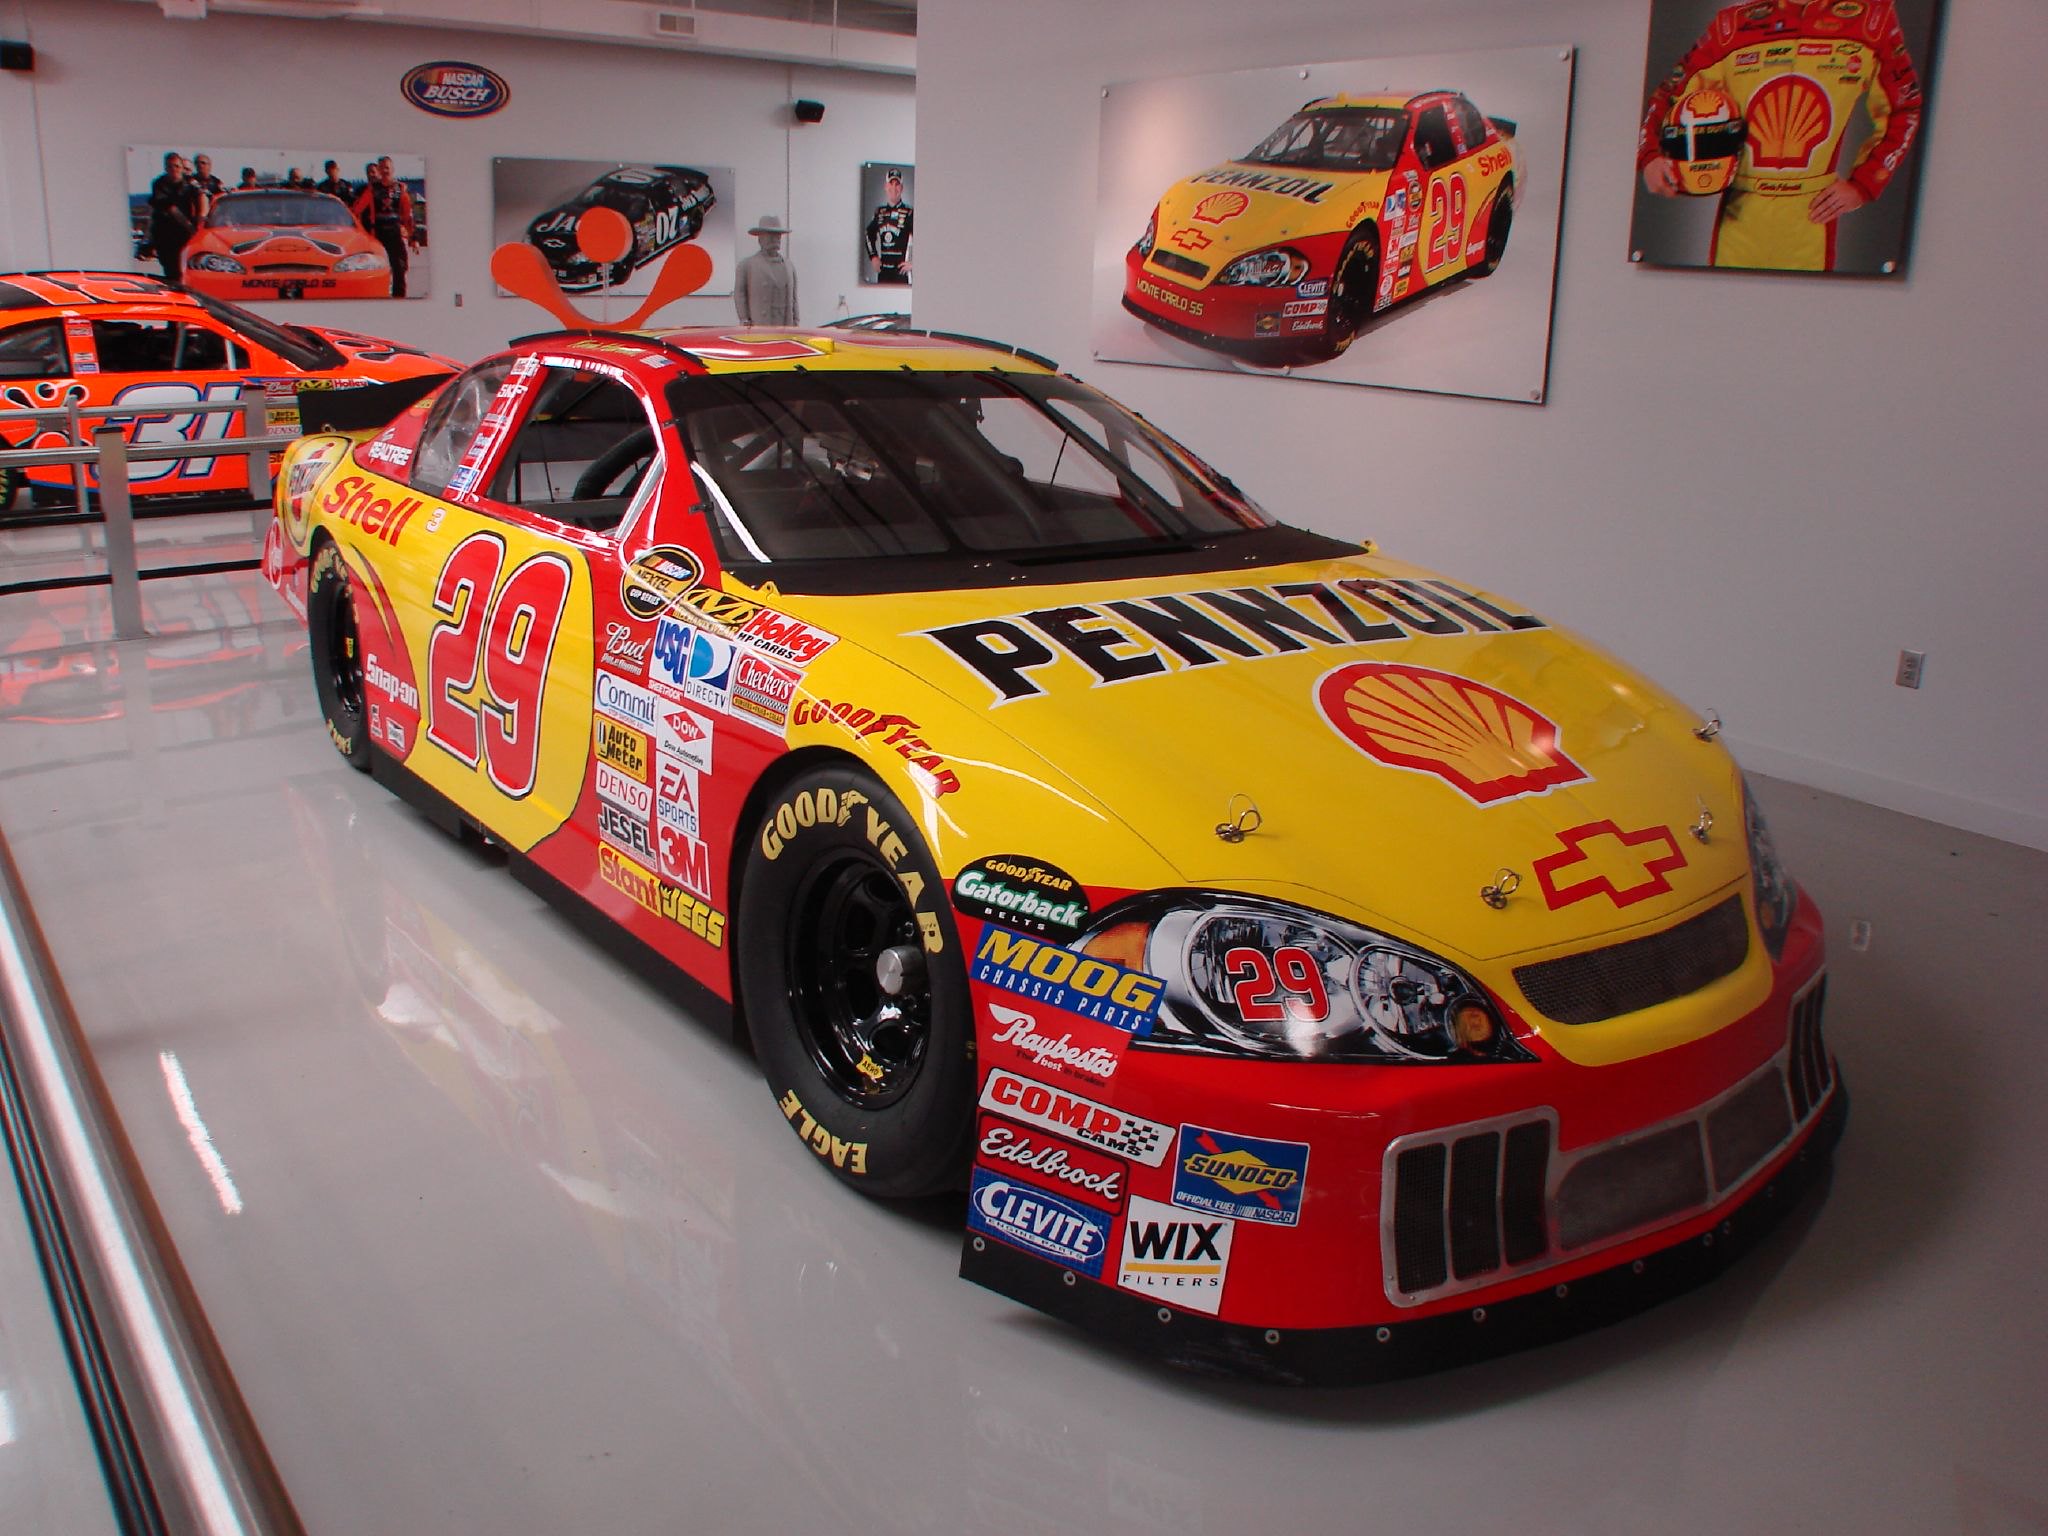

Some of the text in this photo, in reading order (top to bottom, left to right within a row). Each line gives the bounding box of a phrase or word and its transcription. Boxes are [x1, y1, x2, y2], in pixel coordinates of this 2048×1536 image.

[423, 85, 492, 101] BUSCH
[442, 72, 485, 87] NASCAR
[1478, 148, 1513, 176] Shell
[1190, 169, 1336, 205] PENNZOIL
[1424, 170, 1467, 273] 29
[241, 279, 281, 288] MONTE
[1136, 277, 1204, 316] MONTE CARLO SS
[1284, 301, 1318, 315] COMP
[268, 425, 301, 435] DENSO
[368, 441, 412, 466] REALTREE
[323, 475, 424, 547] Shell
[426, 507, 447, 533] 3
[606, 622, 652, 660] Bud
[655, 619, 691, 685] USG
[737, 632, 797, 660] HP CARBS
[743, 610, 831, 662] Holley
[922, 578, 1552, 708] PENNZOIL
[426, 529, 573, 801] 29
[738, 658, 793, 700] Checkers
[596, 674, 657, 722] Commit
[687, 682, 728, 708] DIRECTV
[608, 725, 637, 753] Auto
[672, 714, 699, 739] DOW
[606, 740, 643, 770] Meter
[793, 699, 961, 799] GOODYEAR
[599, 769, 648, 812] DENSO
[660, 763, 695, 813] EA
[599, 805, 656, 858] JESEL
[658, 798, 698, 833] SPORTS
[660, 826, 709, 899] 3M
[760, 787, 945, 954] GOODYEAR
[984, 858, 1073, 892] GOODYEAR
[661, 886, 727, 949] JEGS
[954, 870, 1088, 928] Gatorback
[984, 906, 1046, 931] BELTS
[977, 928, 1163, 1013] MOOG
[1224, 946, 1331, 1022] 29
[980, 965, 1142, 1031] CHASSIS PARTS
[988, 1003, 1118, 1078] Raybestos
[1040, 1058, 1063, 1072] best
[990, 1076, 1122, 1136] COMP
[778, 1088, 869, 1175] EAGLE
[1076, 1127, 1142, 1158] CAMS
[980, 1127, 1122, 1200] Edelbrock
[1189, 1155, 1295, 1188] SUNOCO
[980, 1181, 1099, 1253] CLEVITE
[1176, 1190, 1236, 1211] OFFICIAL FUEL
[1129, 1219, 1226, 1262] WIX
[1122, 1273, 1220, 1288] FILTERS
